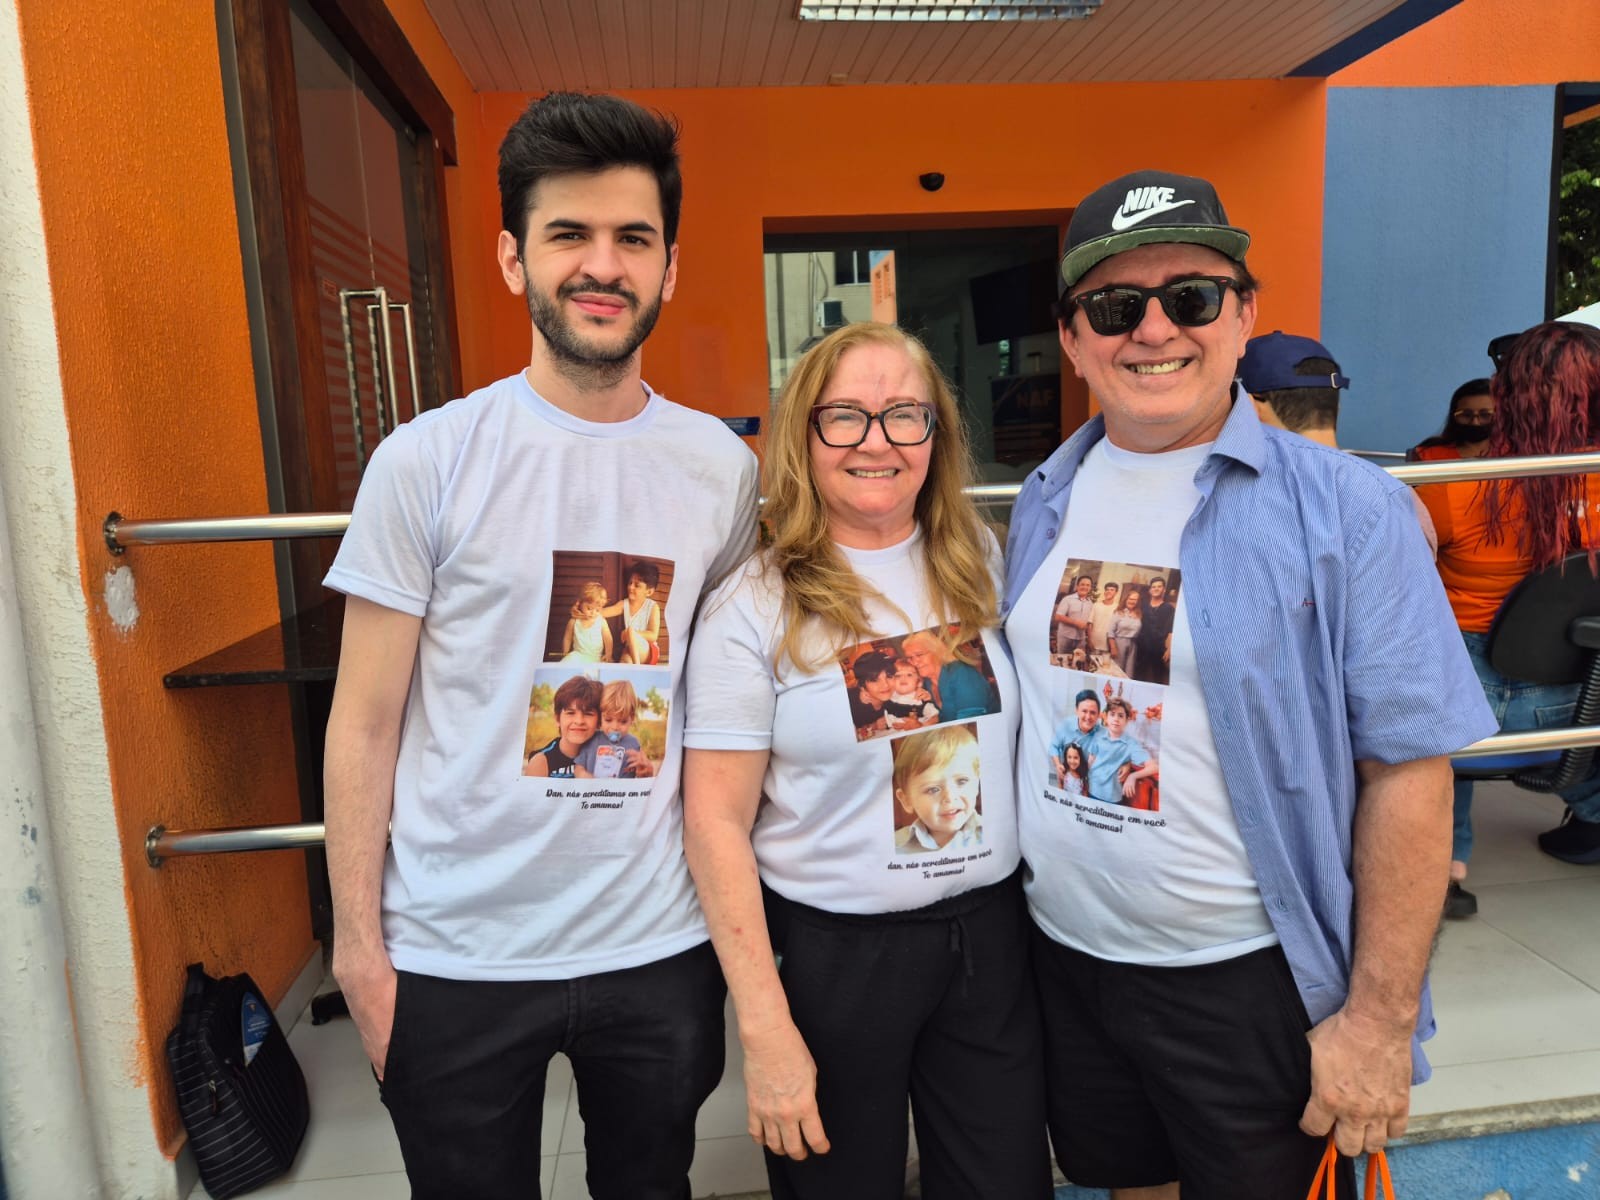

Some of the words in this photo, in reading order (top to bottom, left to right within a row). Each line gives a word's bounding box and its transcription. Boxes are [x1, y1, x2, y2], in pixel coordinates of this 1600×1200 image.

[1123, 186, 1175, 214] NIKE
[583, 788, 626, 798] acreditamos
[581, 801, 589, 810] Te
[590, 800, 624, 809] amamos!
[1075, 803, 1125, 822] acreditamos
[1128, 816, 1142, 824] em
[1144, 818, 1166, 827] você
[1075, 813, 1084, 823] Te
[1085, 817, 1123, 833] amamos!
[922, 856, 965, 868] acreditamos
[967, 854, 977, 862] em
[923, 871, 931, 879] Te
[933, 866, 965, 878] amamos!
